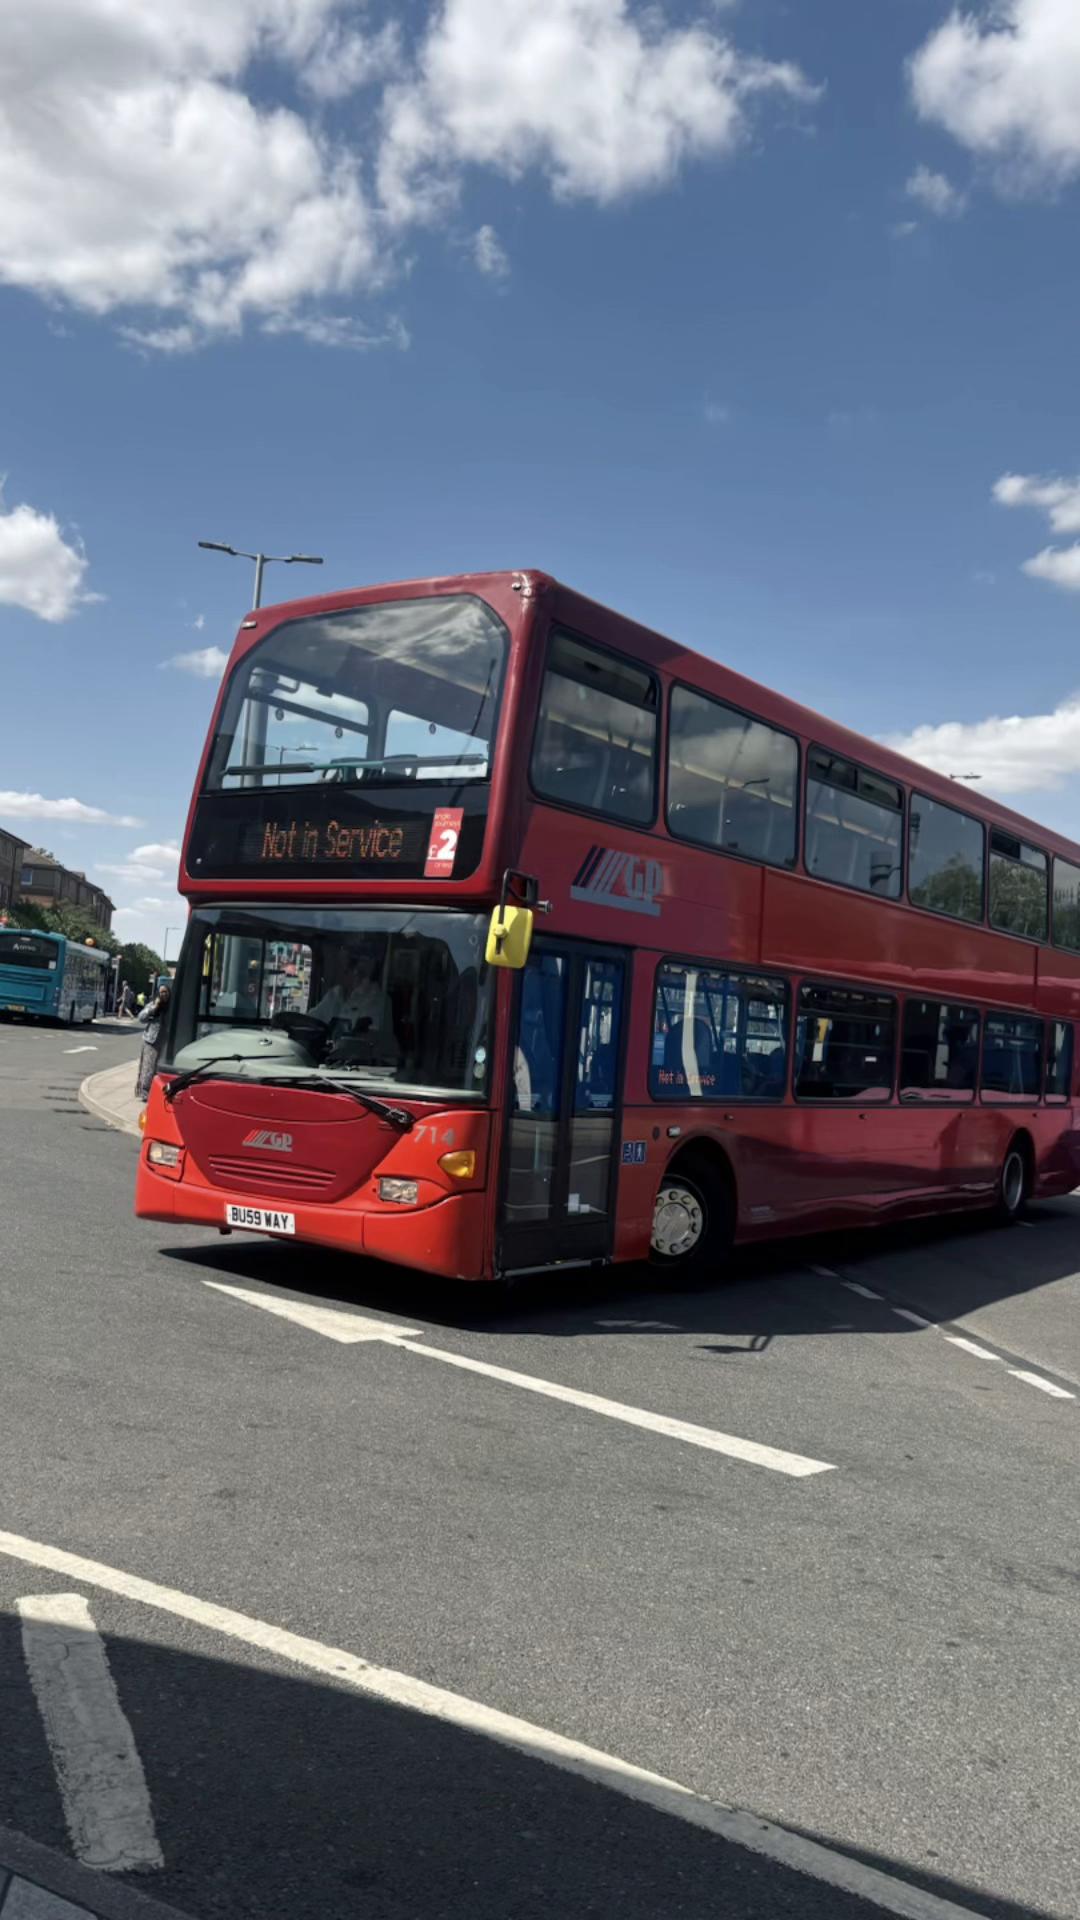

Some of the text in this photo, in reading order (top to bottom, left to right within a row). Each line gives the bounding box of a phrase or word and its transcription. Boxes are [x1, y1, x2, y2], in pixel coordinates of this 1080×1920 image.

[263, 818, 404, 858] Not in Service
[427, 829, 457, 860] £2
[657, 1069, 675, 1085] Not
[414, 1126, 455, 1146] 714
[231, 1206, 289, 1230] BU59 WAY
